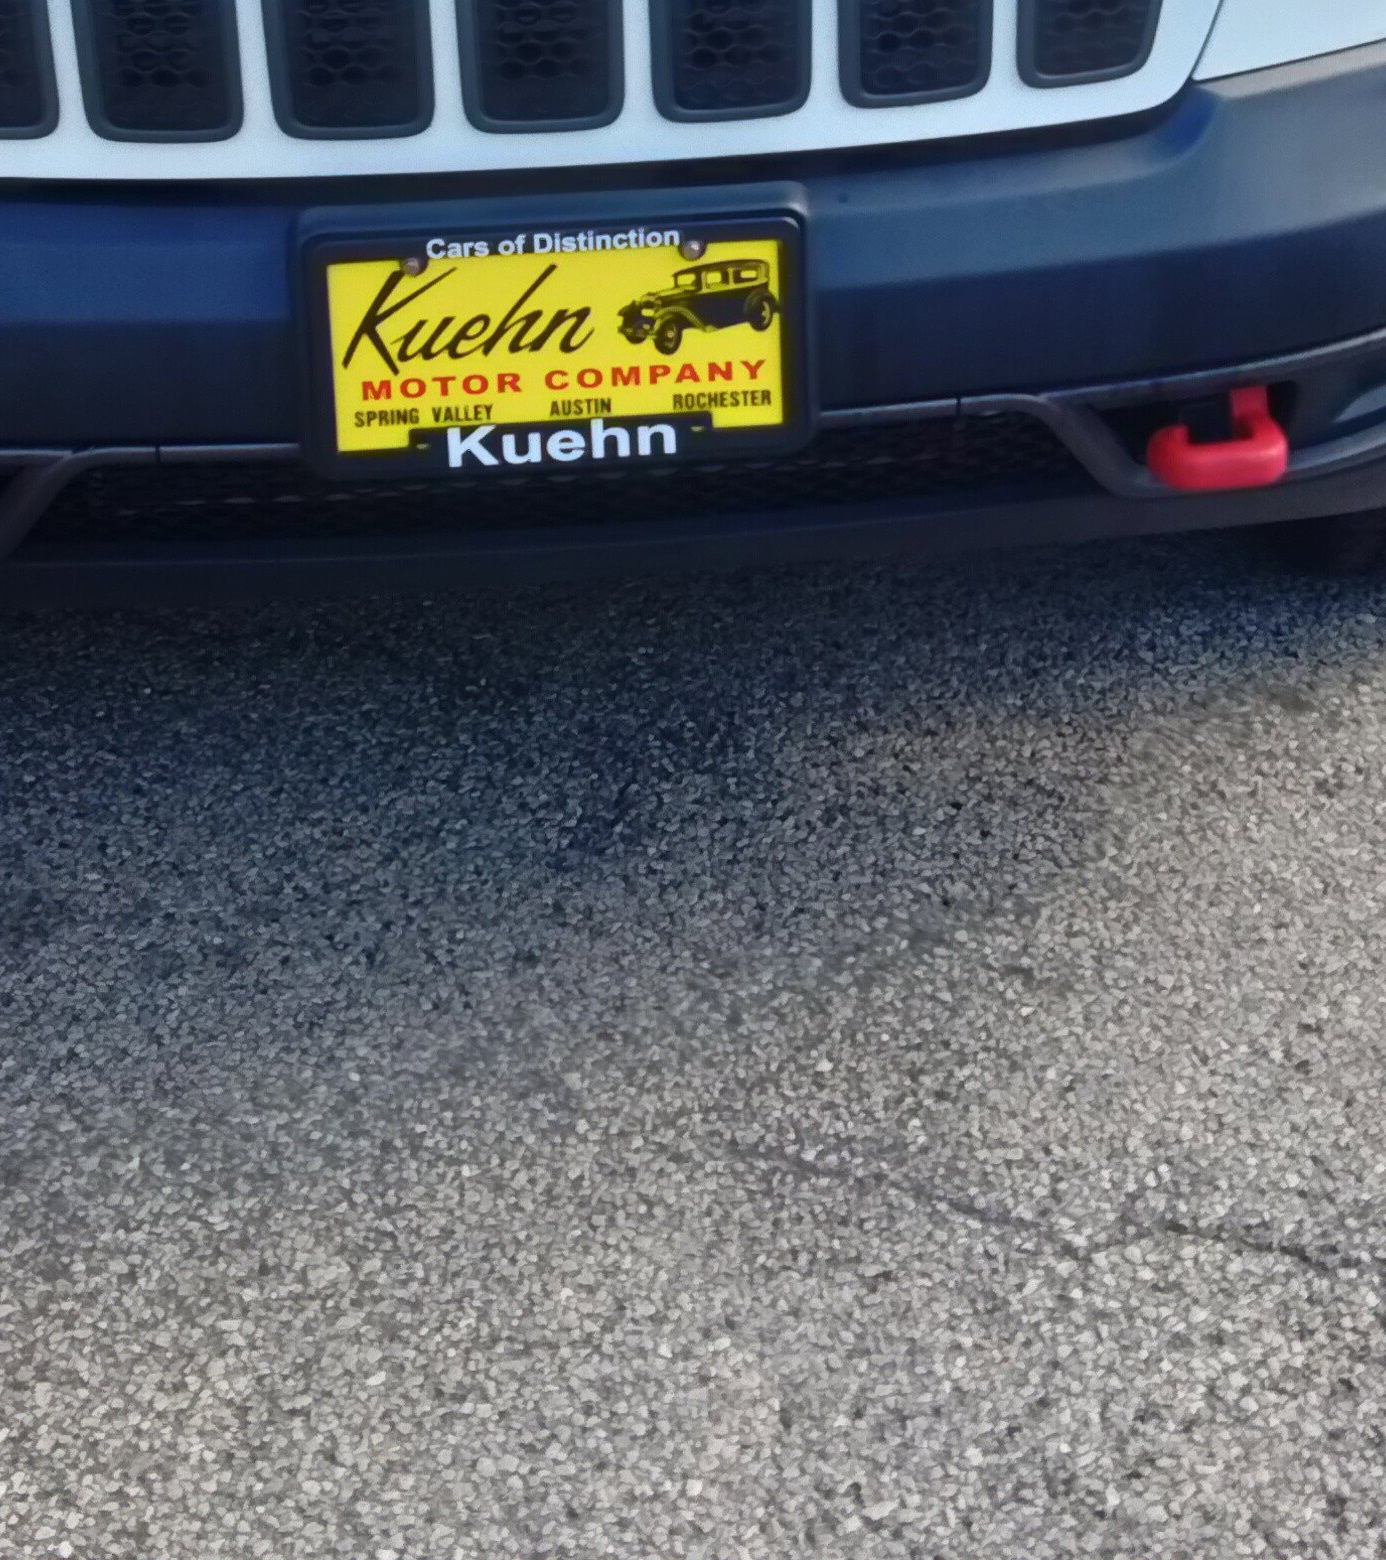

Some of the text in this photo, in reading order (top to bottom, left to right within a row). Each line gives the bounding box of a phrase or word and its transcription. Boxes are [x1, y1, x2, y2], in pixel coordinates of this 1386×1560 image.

[425, 227, 681, 260] Cars of Distinction
[342, 264, 595, 375] Kuehn
[361, 359, 767, 401] MOTOR COMPANY
[354, 390, 773, 428] SPRING VALLEY AUSTIN ROCHESTER
[446, 417, 677, 468] Kuehn
